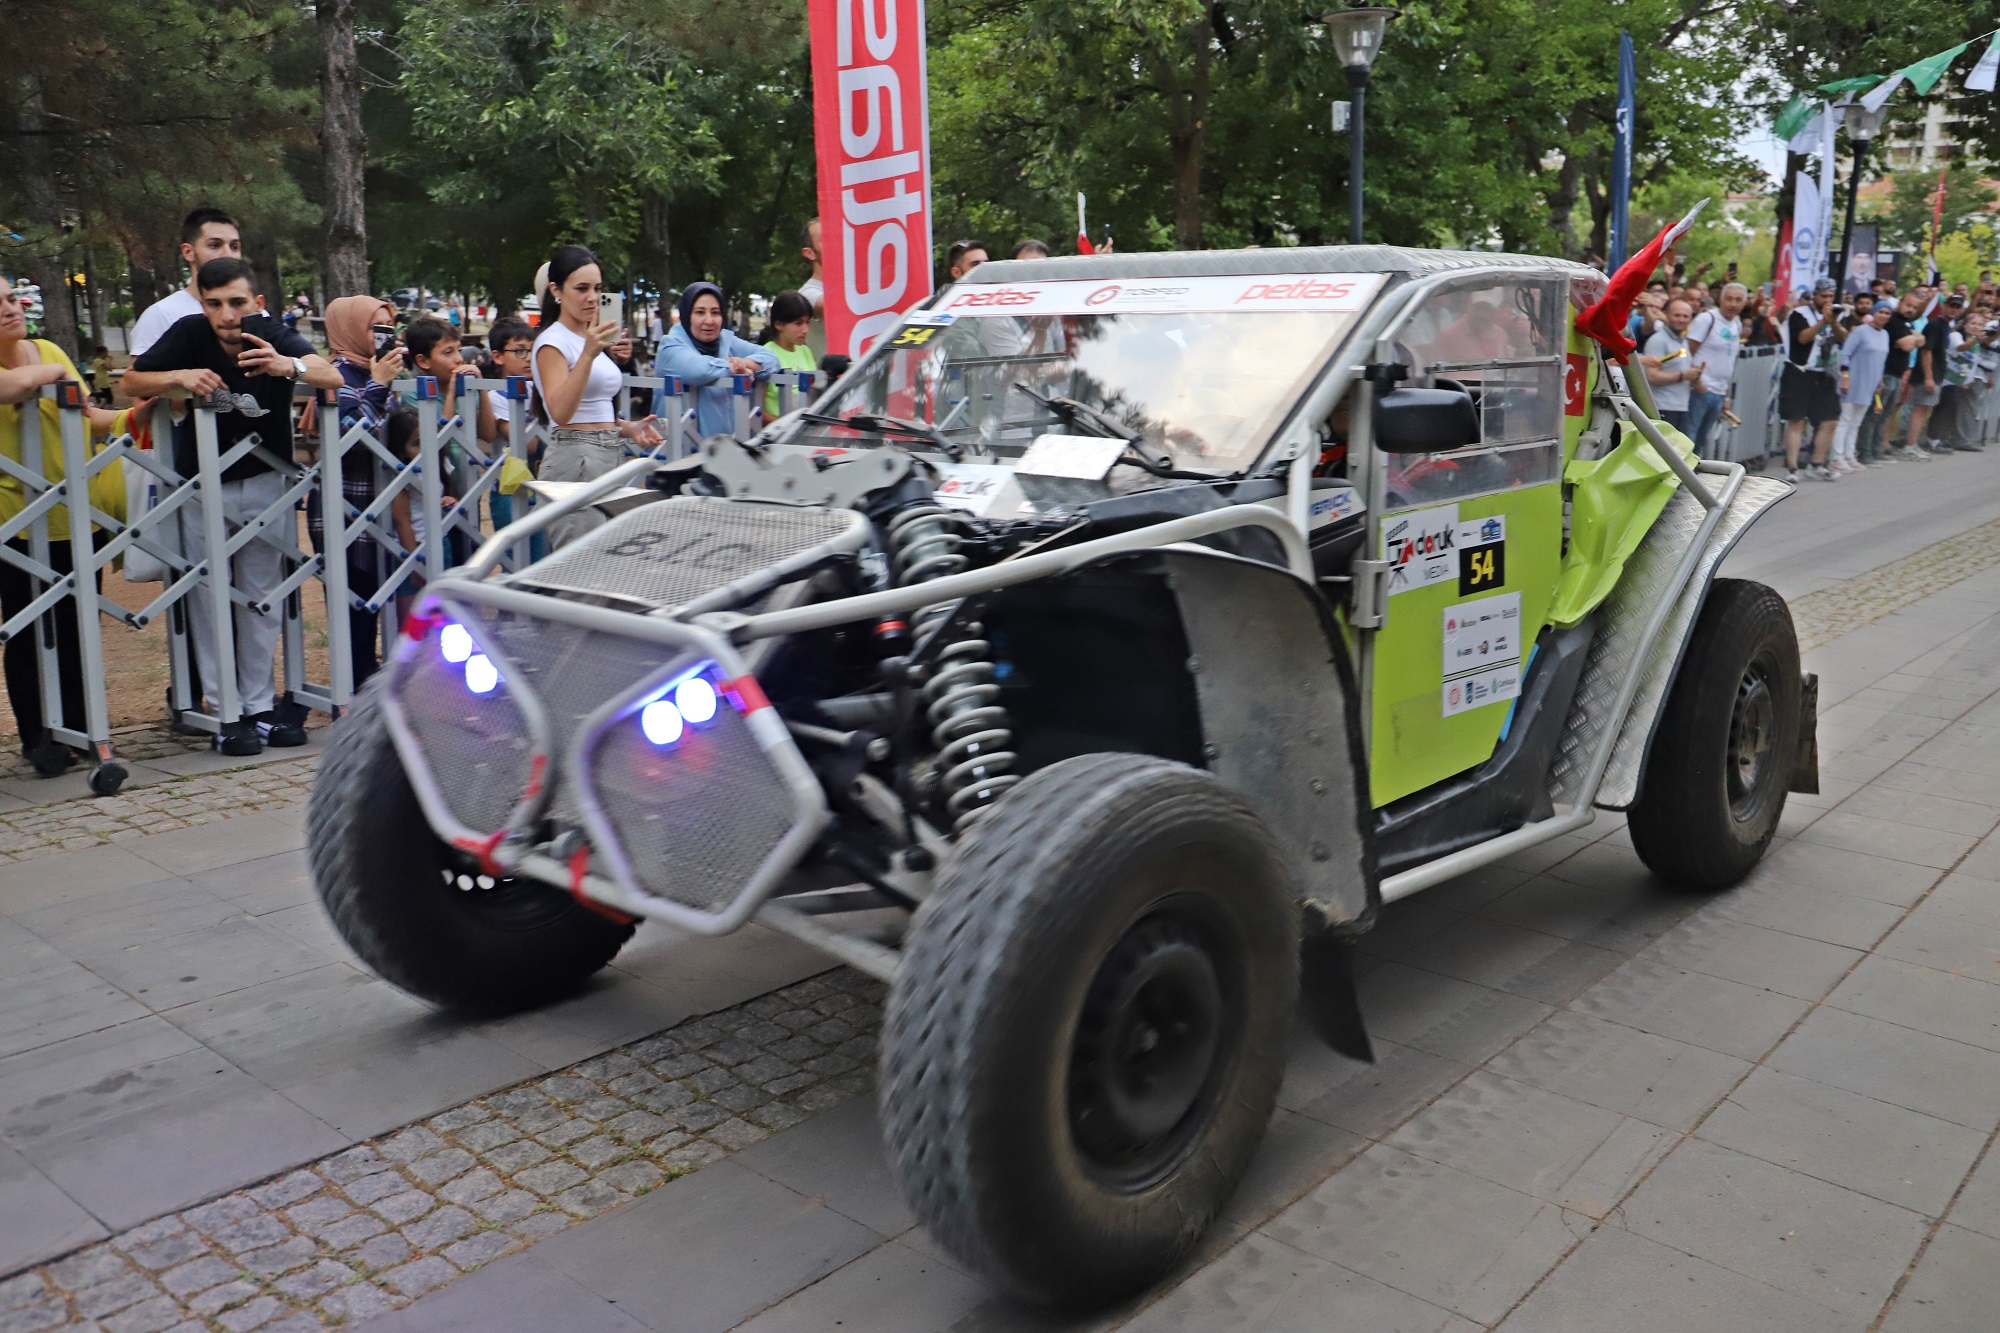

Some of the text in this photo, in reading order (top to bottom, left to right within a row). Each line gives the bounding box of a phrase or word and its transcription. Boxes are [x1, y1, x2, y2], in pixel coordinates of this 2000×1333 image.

[946, 288, 1042, 310] petlas
[1233, 279, 1356, 304] petlas
[892, 327, 937, 345] 54
[1470, 549, 1495, 585] 54
